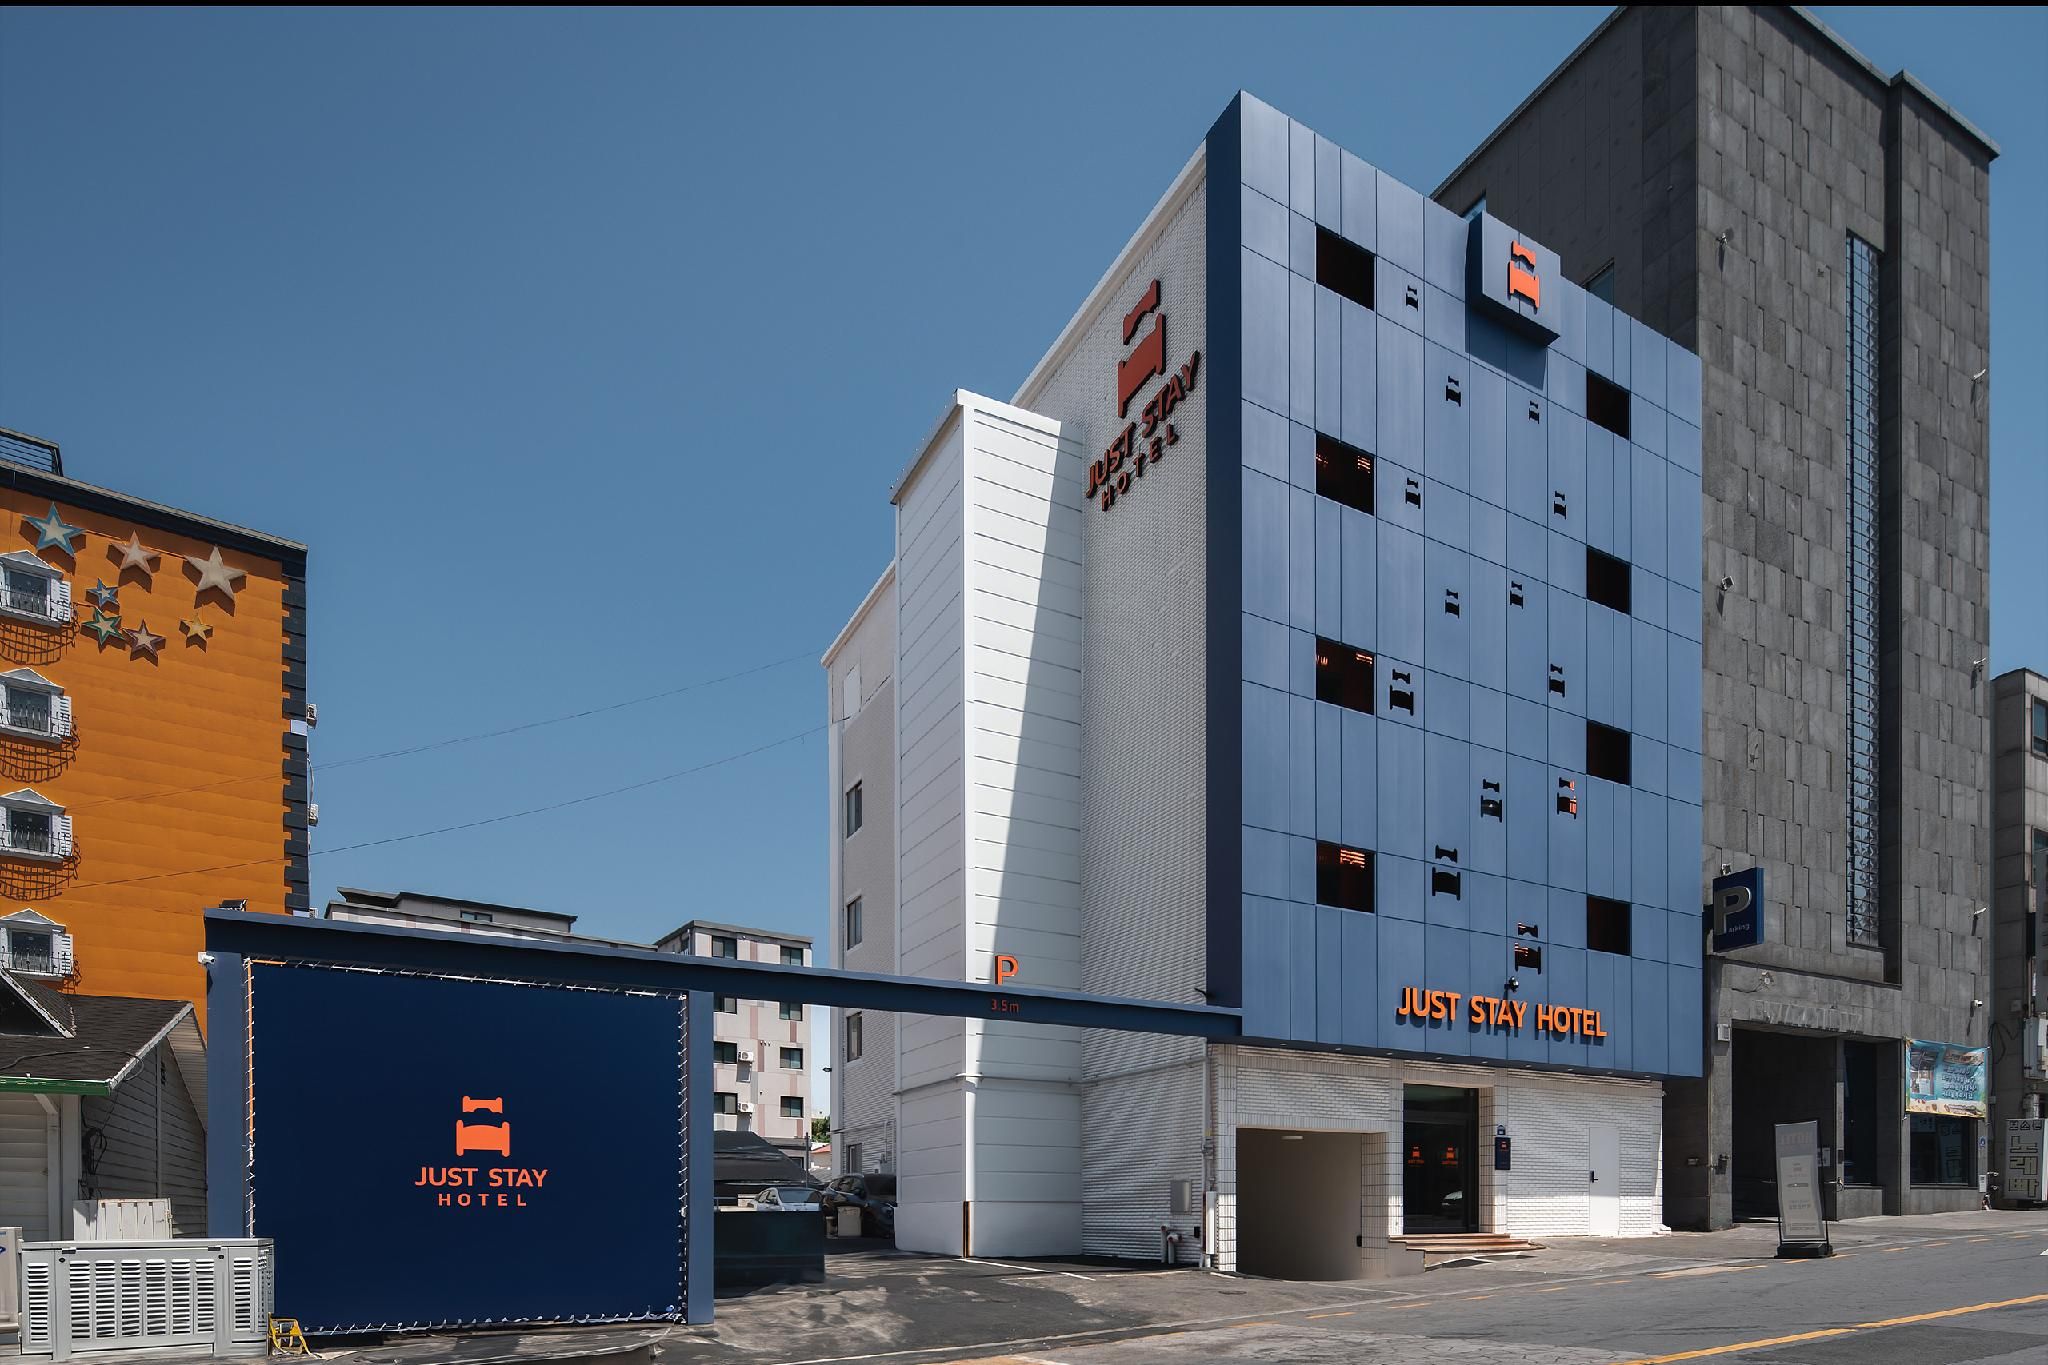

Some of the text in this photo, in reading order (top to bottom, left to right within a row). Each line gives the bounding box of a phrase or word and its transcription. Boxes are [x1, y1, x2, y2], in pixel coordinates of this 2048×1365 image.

[1086, 350, 1201, 498] JUST STAY
[1101, 423, 1180, 512] HOTEL
[995, 955, 1019, 986] P
[1397, 986, 1608, 1037] JUST STAY HOTEL
[414, 1166, 548, 1188] JUST STAY
[437, 1193, 527, 1207] HOTEL
